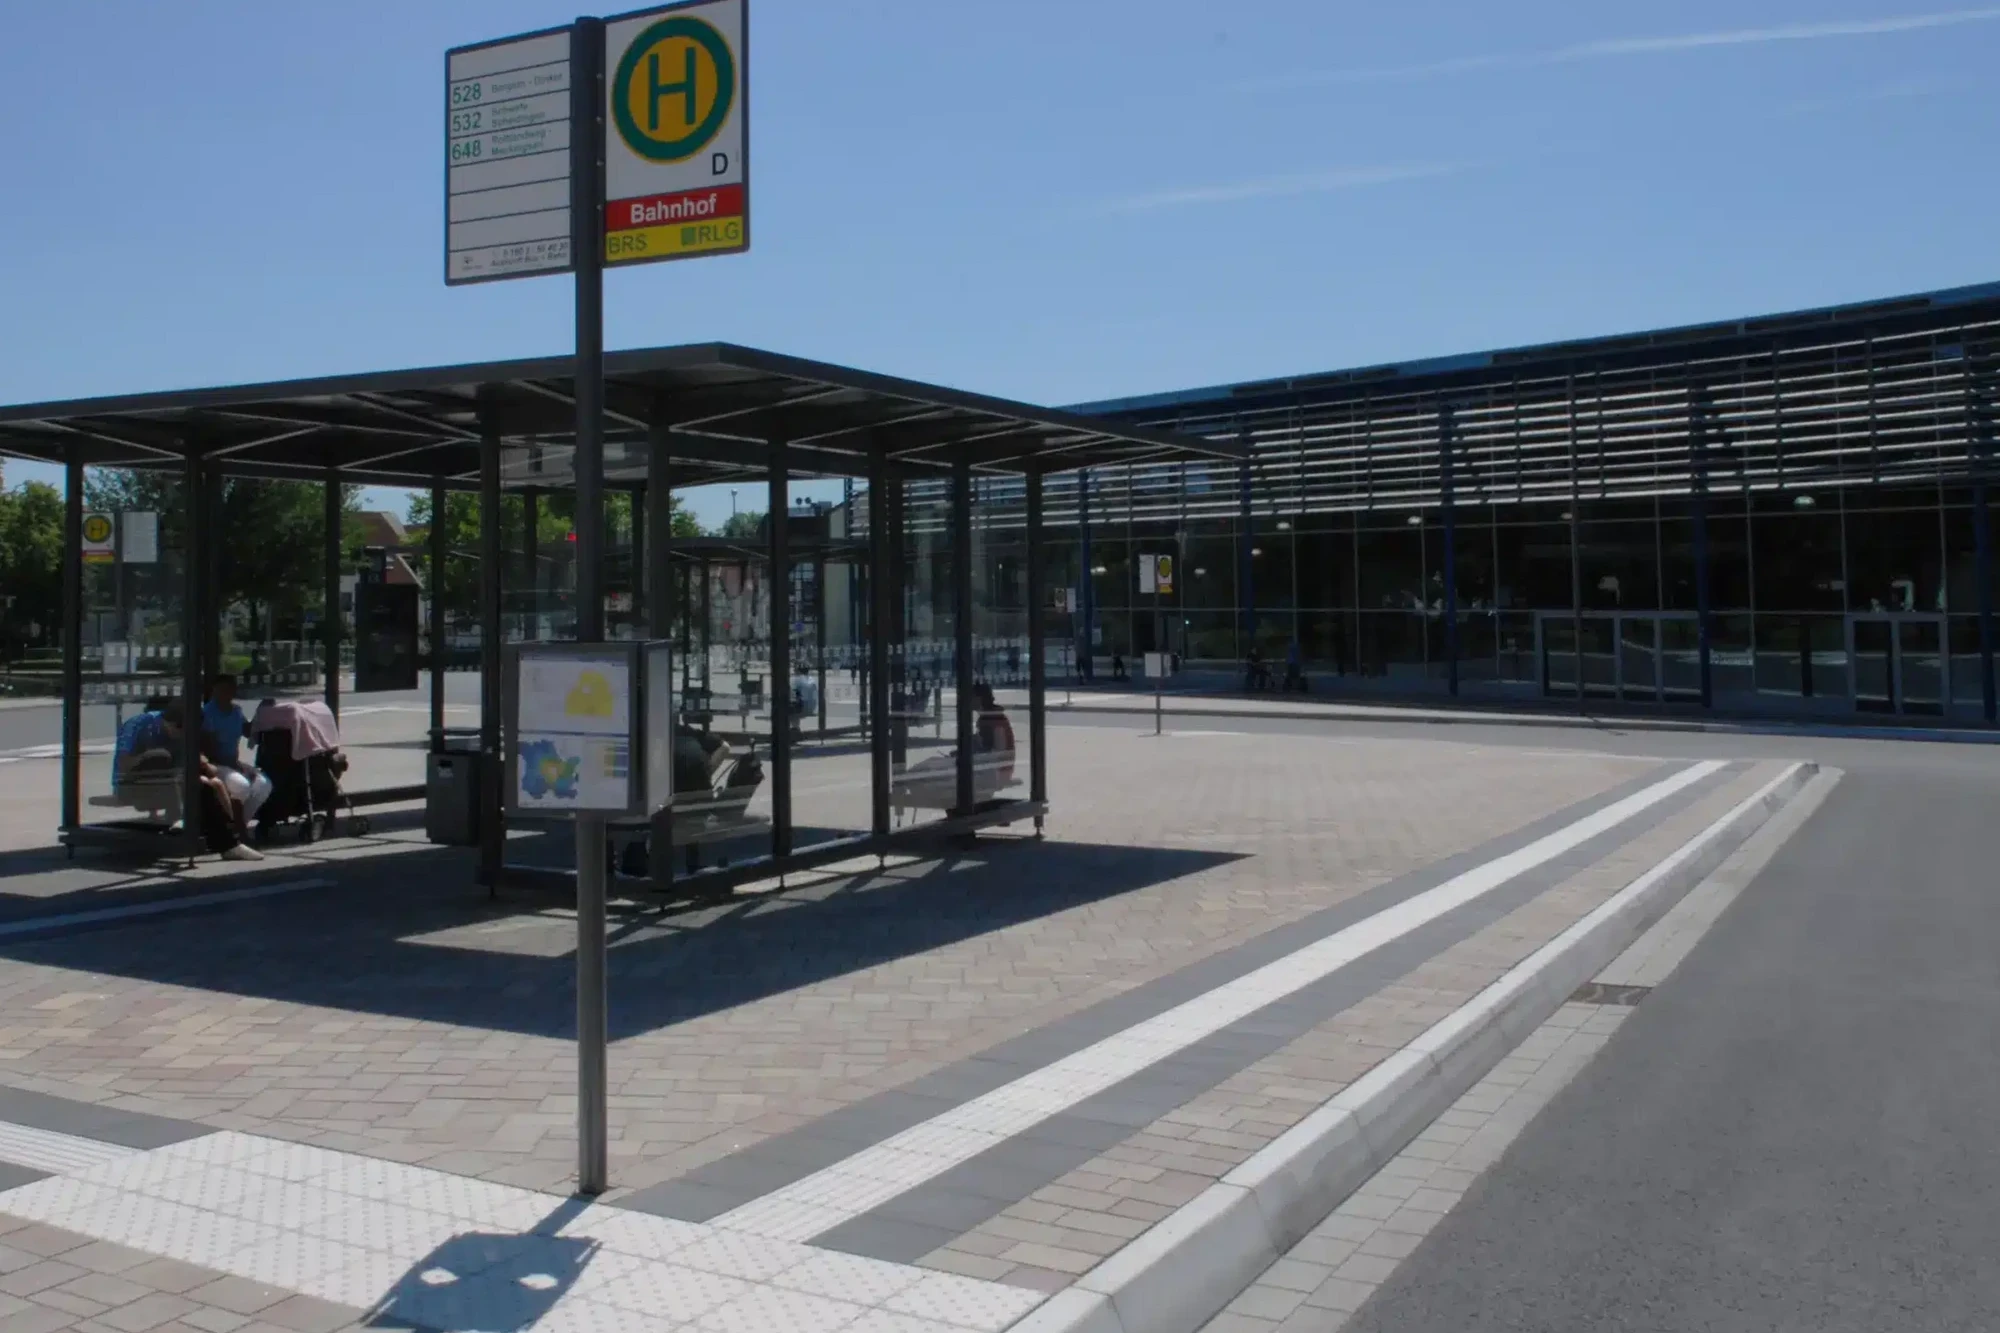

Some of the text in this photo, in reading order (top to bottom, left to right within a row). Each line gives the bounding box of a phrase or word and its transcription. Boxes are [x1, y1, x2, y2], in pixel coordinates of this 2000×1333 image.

[452, 82, 482, 104] 528
[648, 46, 696, 131] H
[452, 111, 482, 133] 532
[451, 139, 482, 161] 648
[711, 152, 729, 176] D
[630, 194, 717, 224] Bahnhof
[608, 233, 648, 254] BRS
[697, 222, 740, 244] RLG
